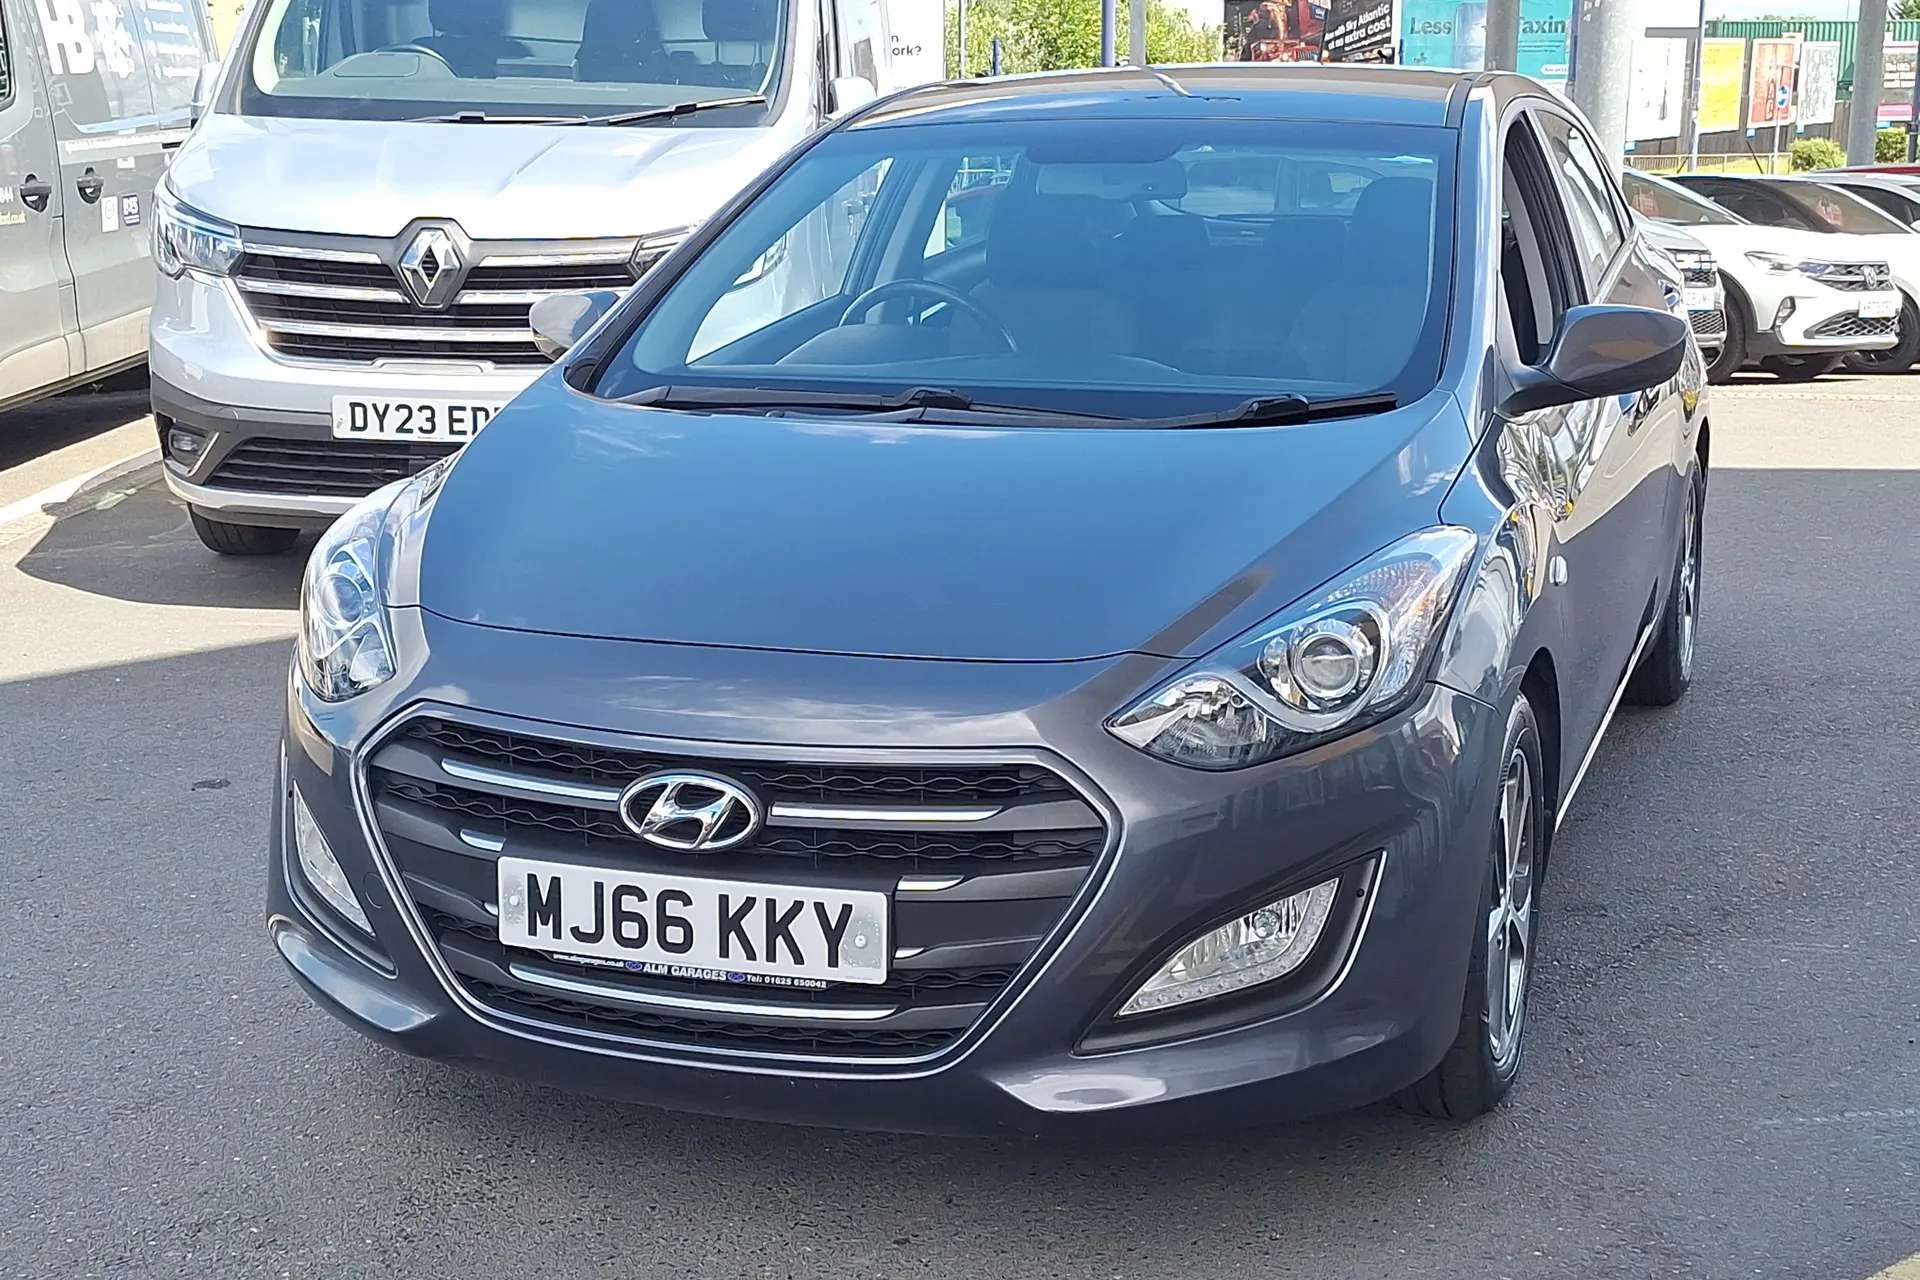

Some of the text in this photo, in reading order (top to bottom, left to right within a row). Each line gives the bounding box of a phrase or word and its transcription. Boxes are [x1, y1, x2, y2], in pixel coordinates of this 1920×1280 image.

[1344, 28, 1366, 44] extra
[1367, 15, 1391, 35] cost
[1345, 20, 1358, 32] Sky
[1358, 3, 1390, 27] Atlantic
[1409, 17, 1452, 35] Less
[892, 45, 922, 56] ork?
[349, 402, 502, 436] DY23 ED
[526, 872, 854, 969] MJ66 KKY
[643, 962, 727, 981] ALM GARAGES
[746, 974, 762, 983] Tel:
[764, 976, 792, 986] 01625
